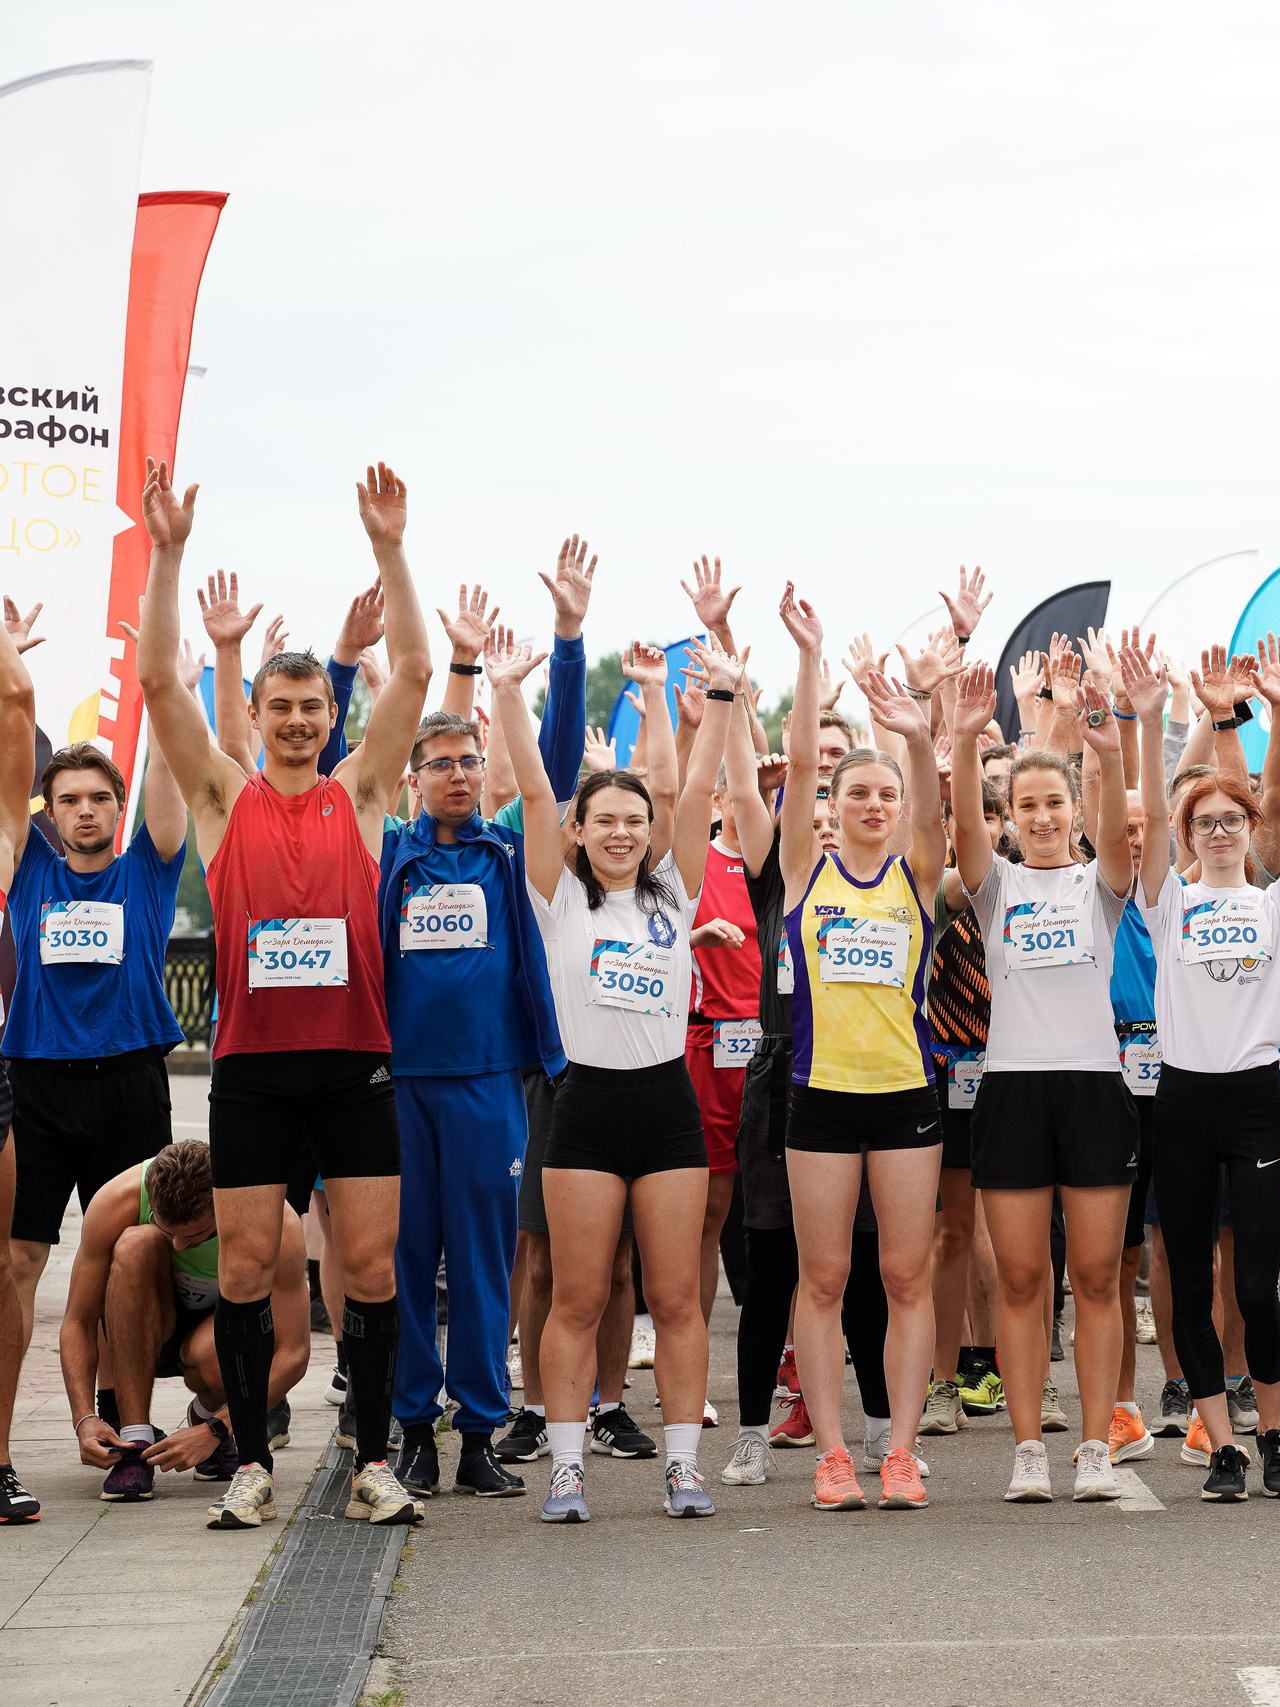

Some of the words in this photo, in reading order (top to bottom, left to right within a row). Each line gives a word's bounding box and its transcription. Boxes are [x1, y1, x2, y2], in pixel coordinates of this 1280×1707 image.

[0, 462, 102, 503] ТОЕ
[814, 905, 845, 915] YSU
[413, 914, 473, 933] 3060
[50, 930, 107, 947] 3030
[1021, 929, 1075, 952] 3021
[1197, 926, 1257, 946] 3020
[264, 950, 331, 970] 3047
[832, 947, 893, 969] 3095
[602, 970, 664, 998] 3050
[963, 1078, 982, 1095] 3
